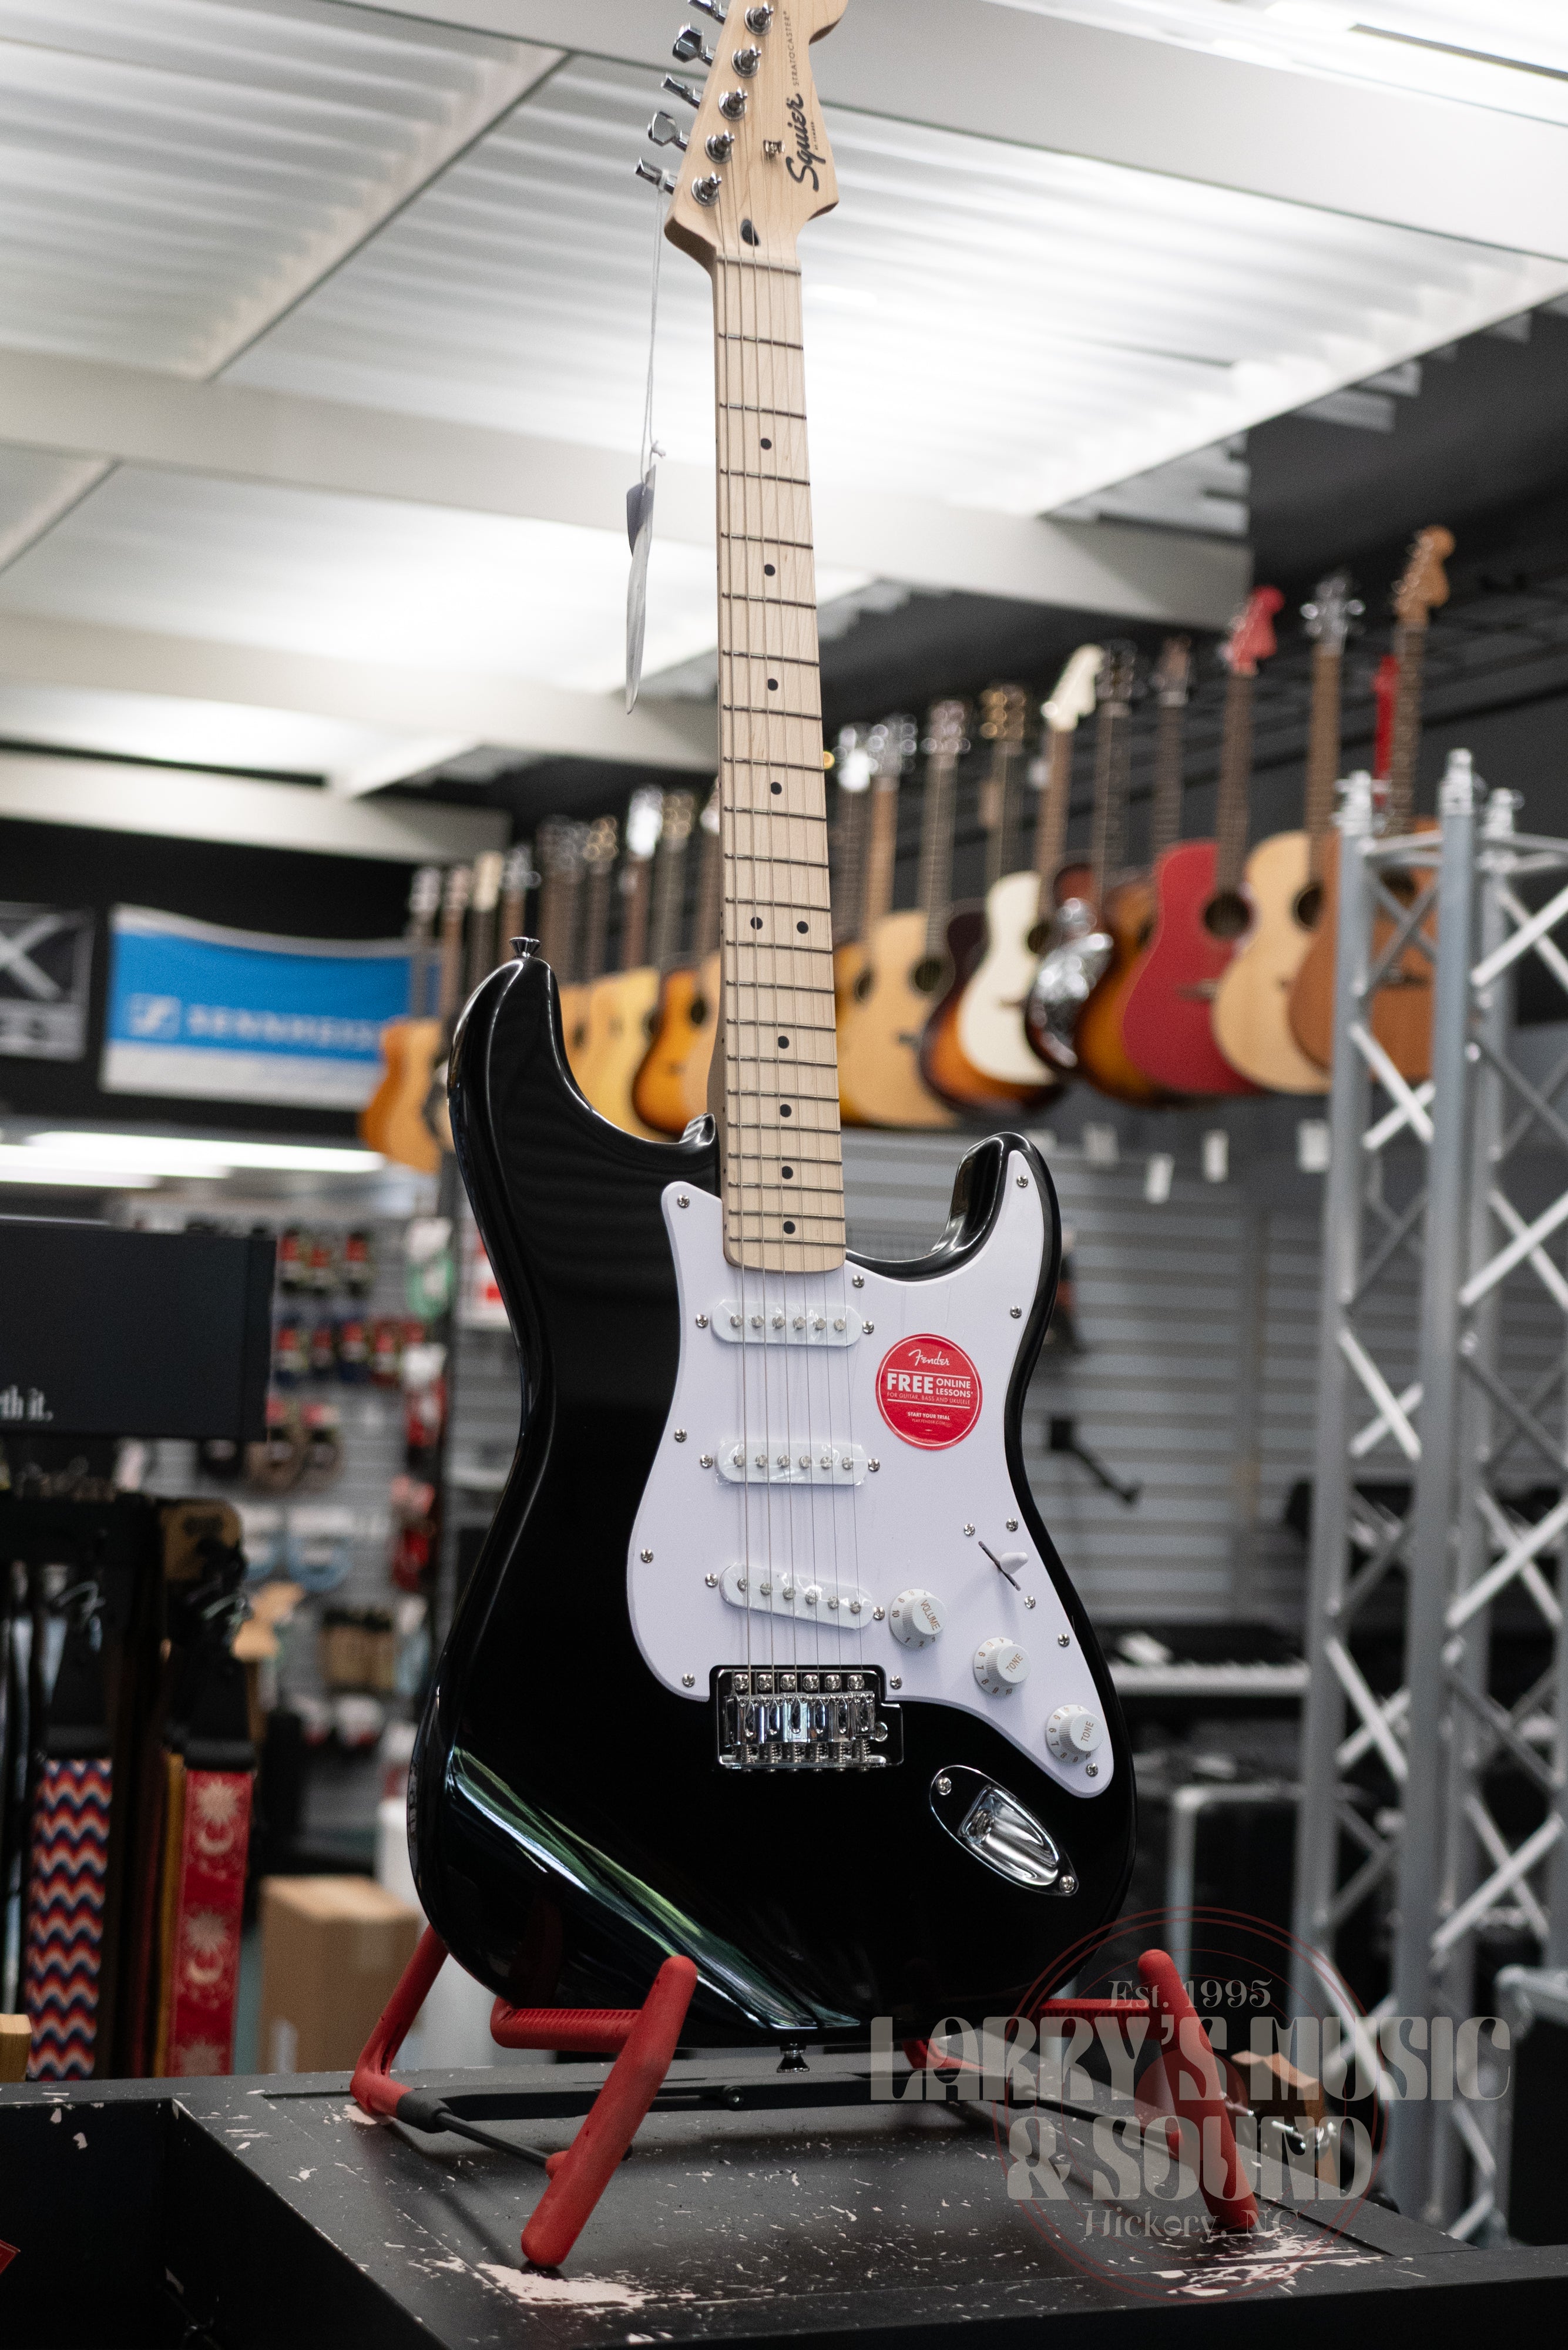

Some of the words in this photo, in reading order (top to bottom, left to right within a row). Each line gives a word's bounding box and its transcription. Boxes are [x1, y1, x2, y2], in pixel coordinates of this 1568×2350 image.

[785, 93, 826, 193] Squier
[908, 1349, 950, 1367] Fender
[887, 1372, 934, 1394] FREE
[936, 1378, 971, 1389] ONLINE
[921, 1599, 941, 1631] VOLUME
[1006, 1653, 1023, 1673] TONE
[1081, 1721, 1094, 1742] TONE
